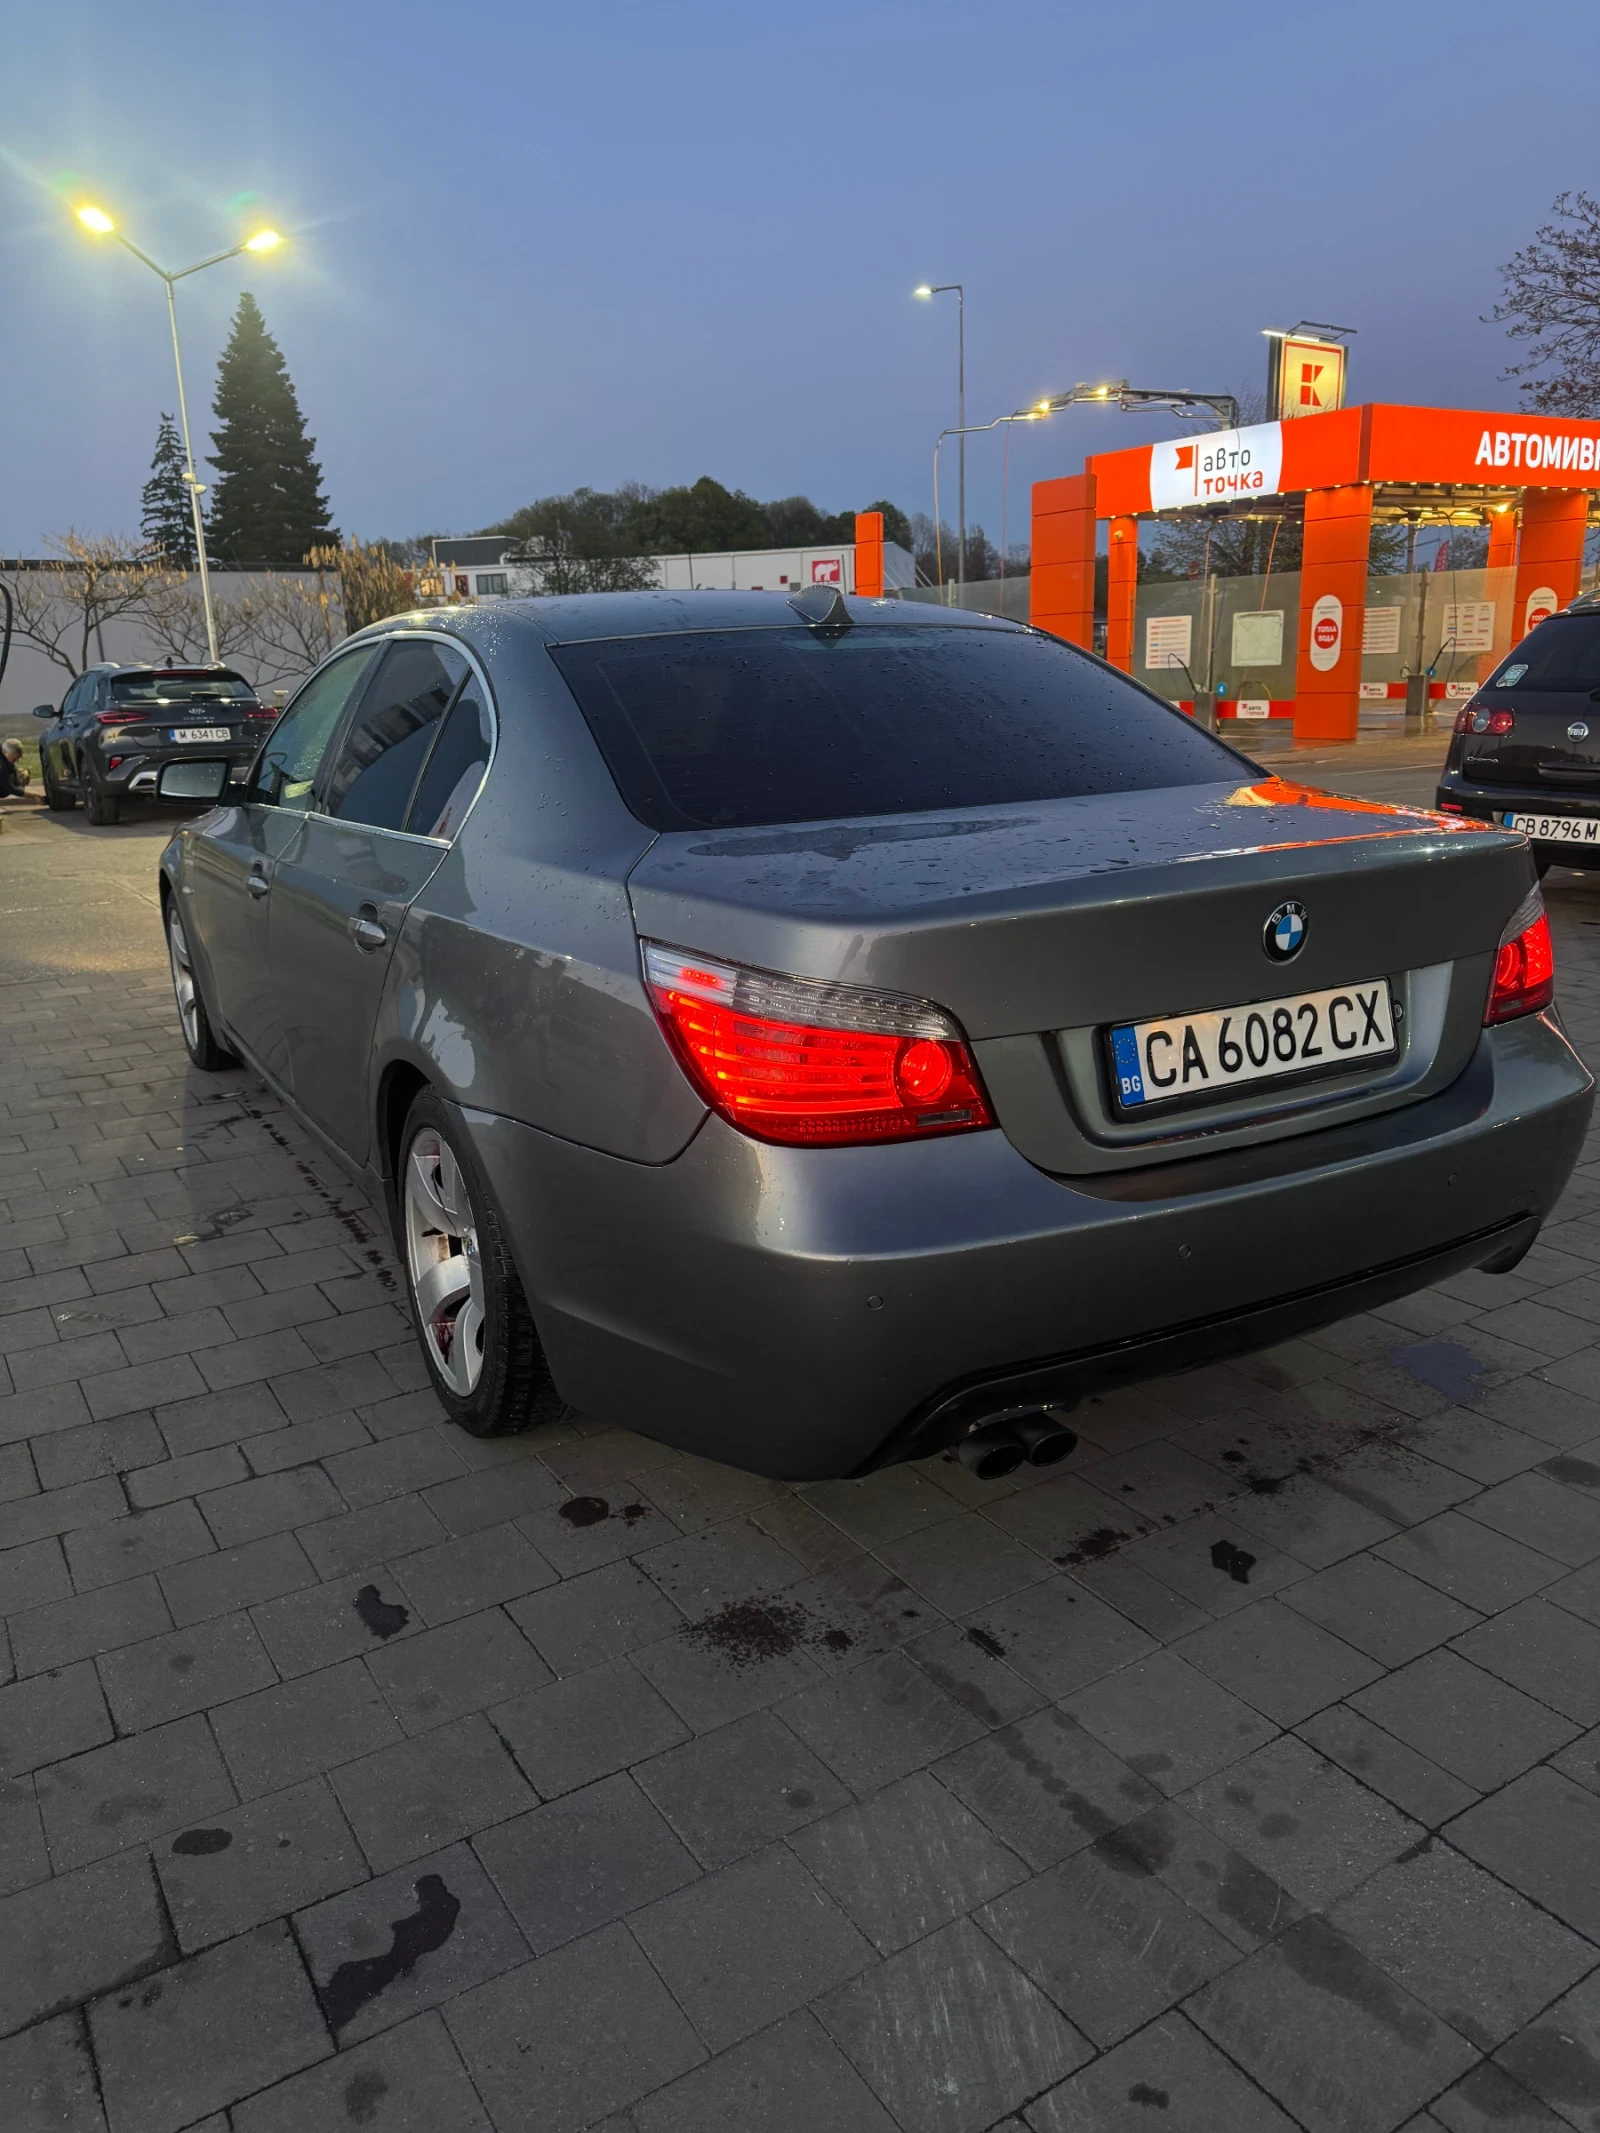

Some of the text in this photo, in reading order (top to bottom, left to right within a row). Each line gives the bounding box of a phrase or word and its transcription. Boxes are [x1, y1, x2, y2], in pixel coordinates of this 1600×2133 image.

[1300, 363, 1324, 407] K
[1203, 447, 1251, 472] авто
[1203, 470, 1264, 495] точка
[191, 729, 214, 739] 6341
[1570, 728, 1585, 736] FIAT
[1515, 817, 1600, 841] CB 8796 M
[1271, 903, 1308, 925] BMW
[1145, 989, 1386, 1088] CA 6082 CX
[1121, 1074, 1141, 1095] BG
